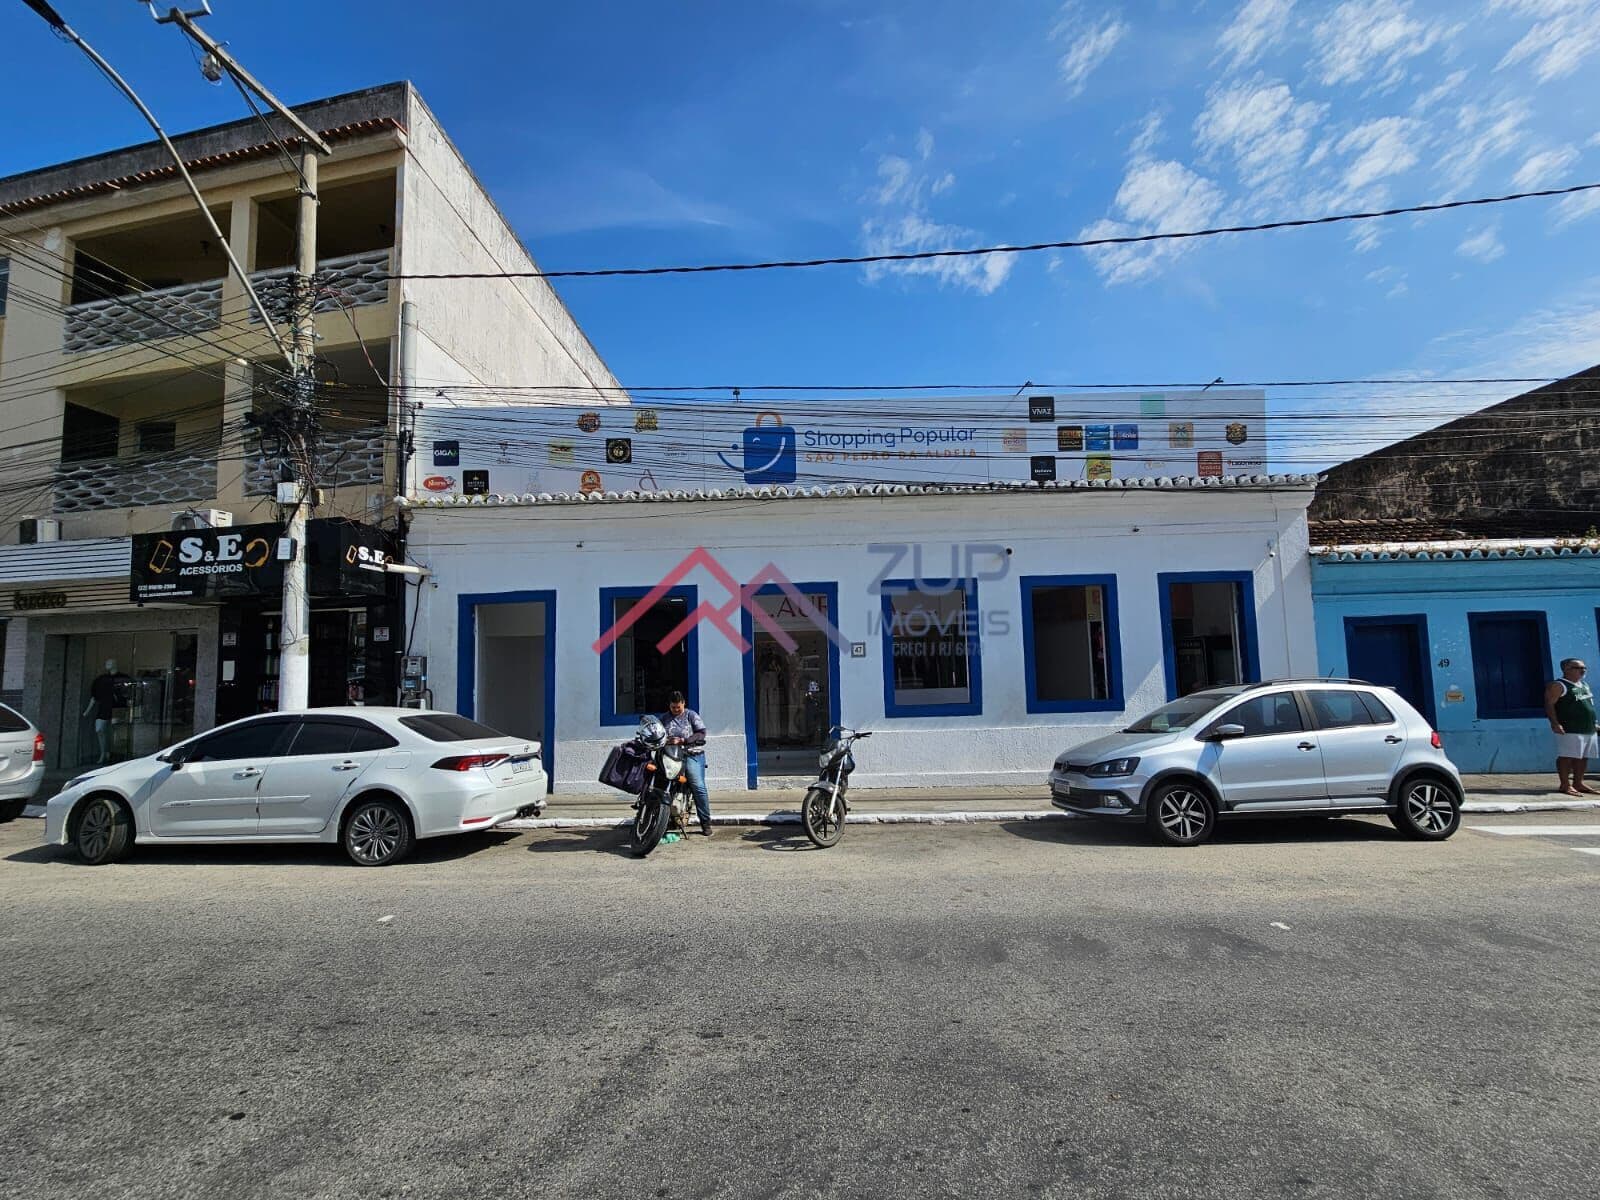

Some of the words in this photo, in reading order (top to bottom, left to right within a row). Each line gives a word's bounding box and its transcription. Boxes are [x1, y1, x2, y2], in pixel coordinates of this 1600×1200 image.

[804, 429, 896, 448] Shopping
[900, 426, 977, 446] Popular
[179, 534, 243, 563] S&E
[179, 562, 243, 576] ACESSÓRIOS
